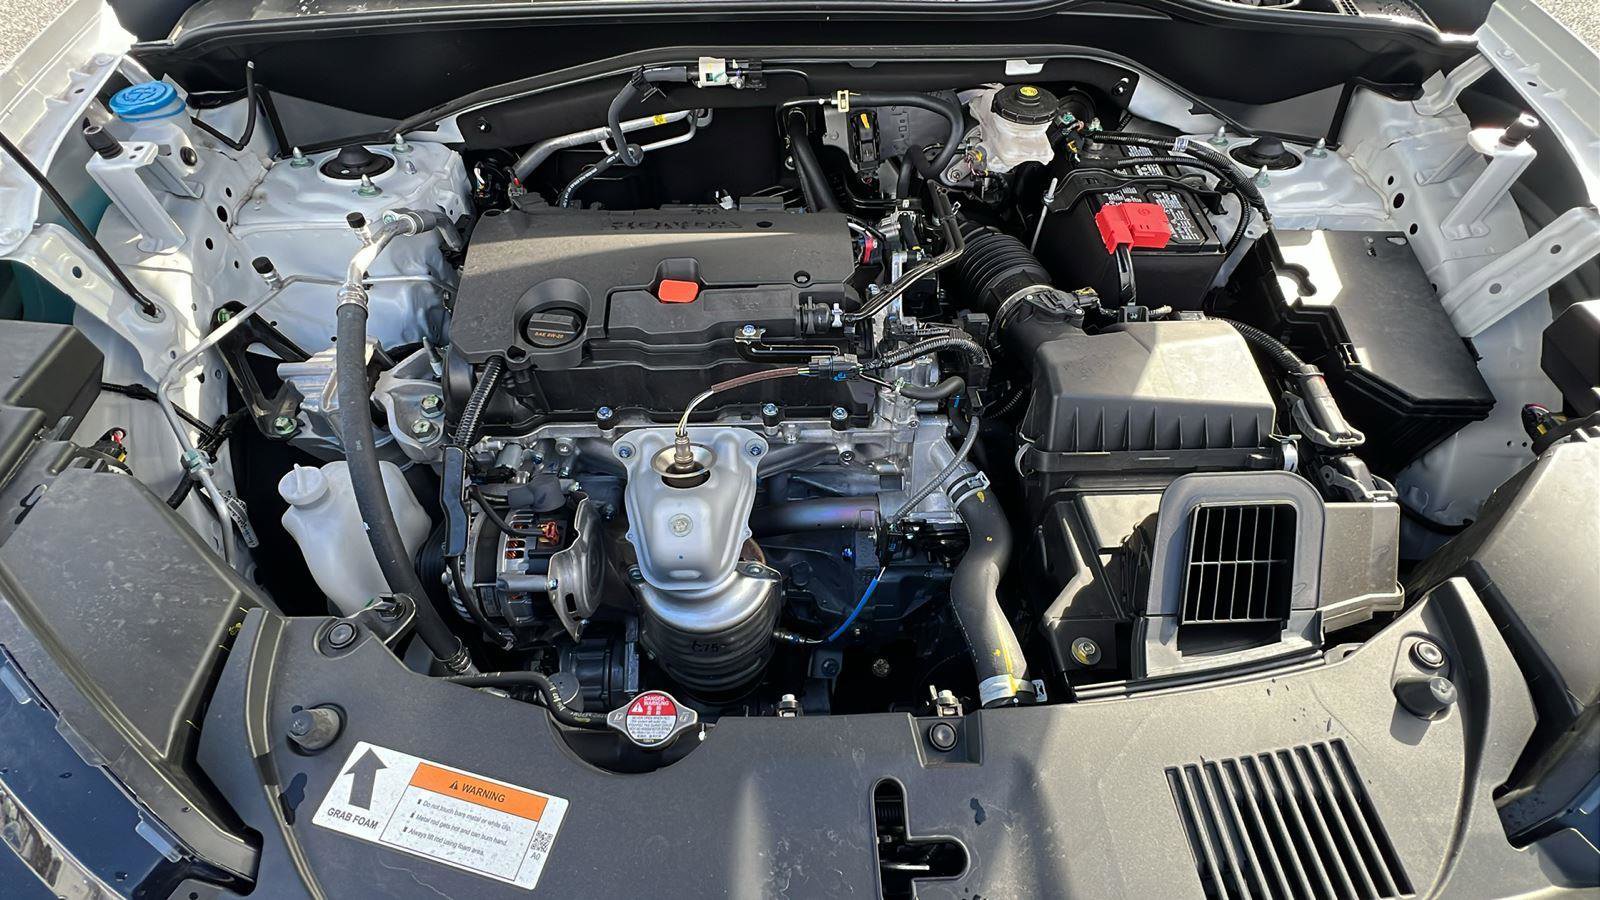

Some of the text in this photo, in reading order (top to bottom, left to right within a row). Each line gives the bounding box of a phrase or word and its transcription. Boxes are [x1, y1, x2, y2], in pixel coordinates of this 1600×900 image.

[462, 783, 506, 803] WARNING
[327, 807, 379, 830] GRAB FOAM
[422, 800, 431, 808] Do
[440, 804, 454, 814] touch
[454, 809, 466, 818] bare
[466, 813, 481, 822] metal
[487, 818, 501, 828] white
[408, 828, 427, 839] Always
[427, 832, 435, 840] lift
[434, 835, 444, 844] rod
[443, 838, 458, 849] using
[457, 842, 472, 852] foam
[415, 814, 431, 823] Metal
[430, 818, 440, 826] rod
[439, 821, 451, 830] gets
[481, 833, 493, 842] burn
